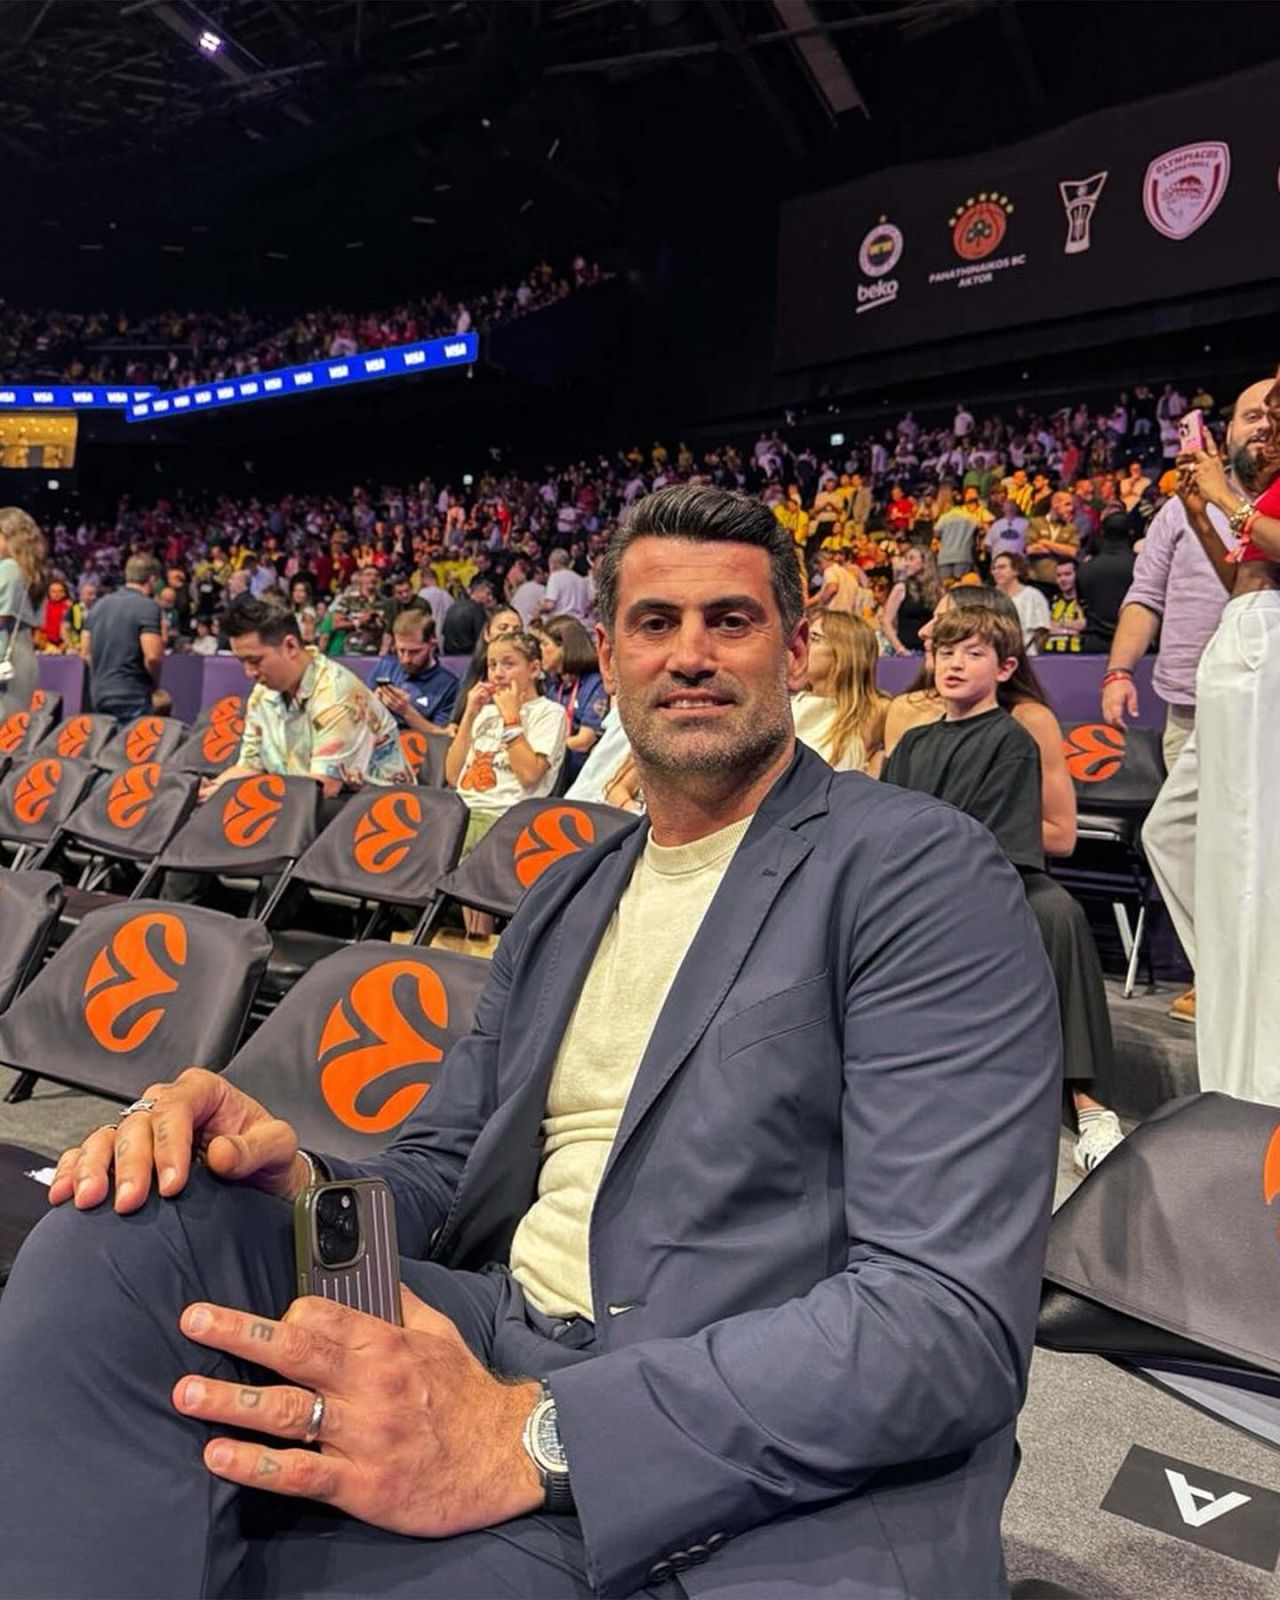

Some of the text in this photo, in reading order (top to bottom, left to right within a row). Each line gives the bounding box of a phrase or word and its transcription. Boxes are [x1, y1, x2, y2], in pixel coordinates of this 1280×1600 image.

[1156, 150, 1219, 174] OLYMPIACOS
[929, 254, 1026, 284] PANATHINAIKOS BC
[957, 273, 993, 288] AKTOR
[856, 280, 899, 302] beko
[445, 343, 466, 357] VISA
[250, 1322, 275, 1342] E
[239, 1388, 261, 1408] D
[258, 1456, 281, 1476] A
[1164, 1468, 1252, 1527] A
